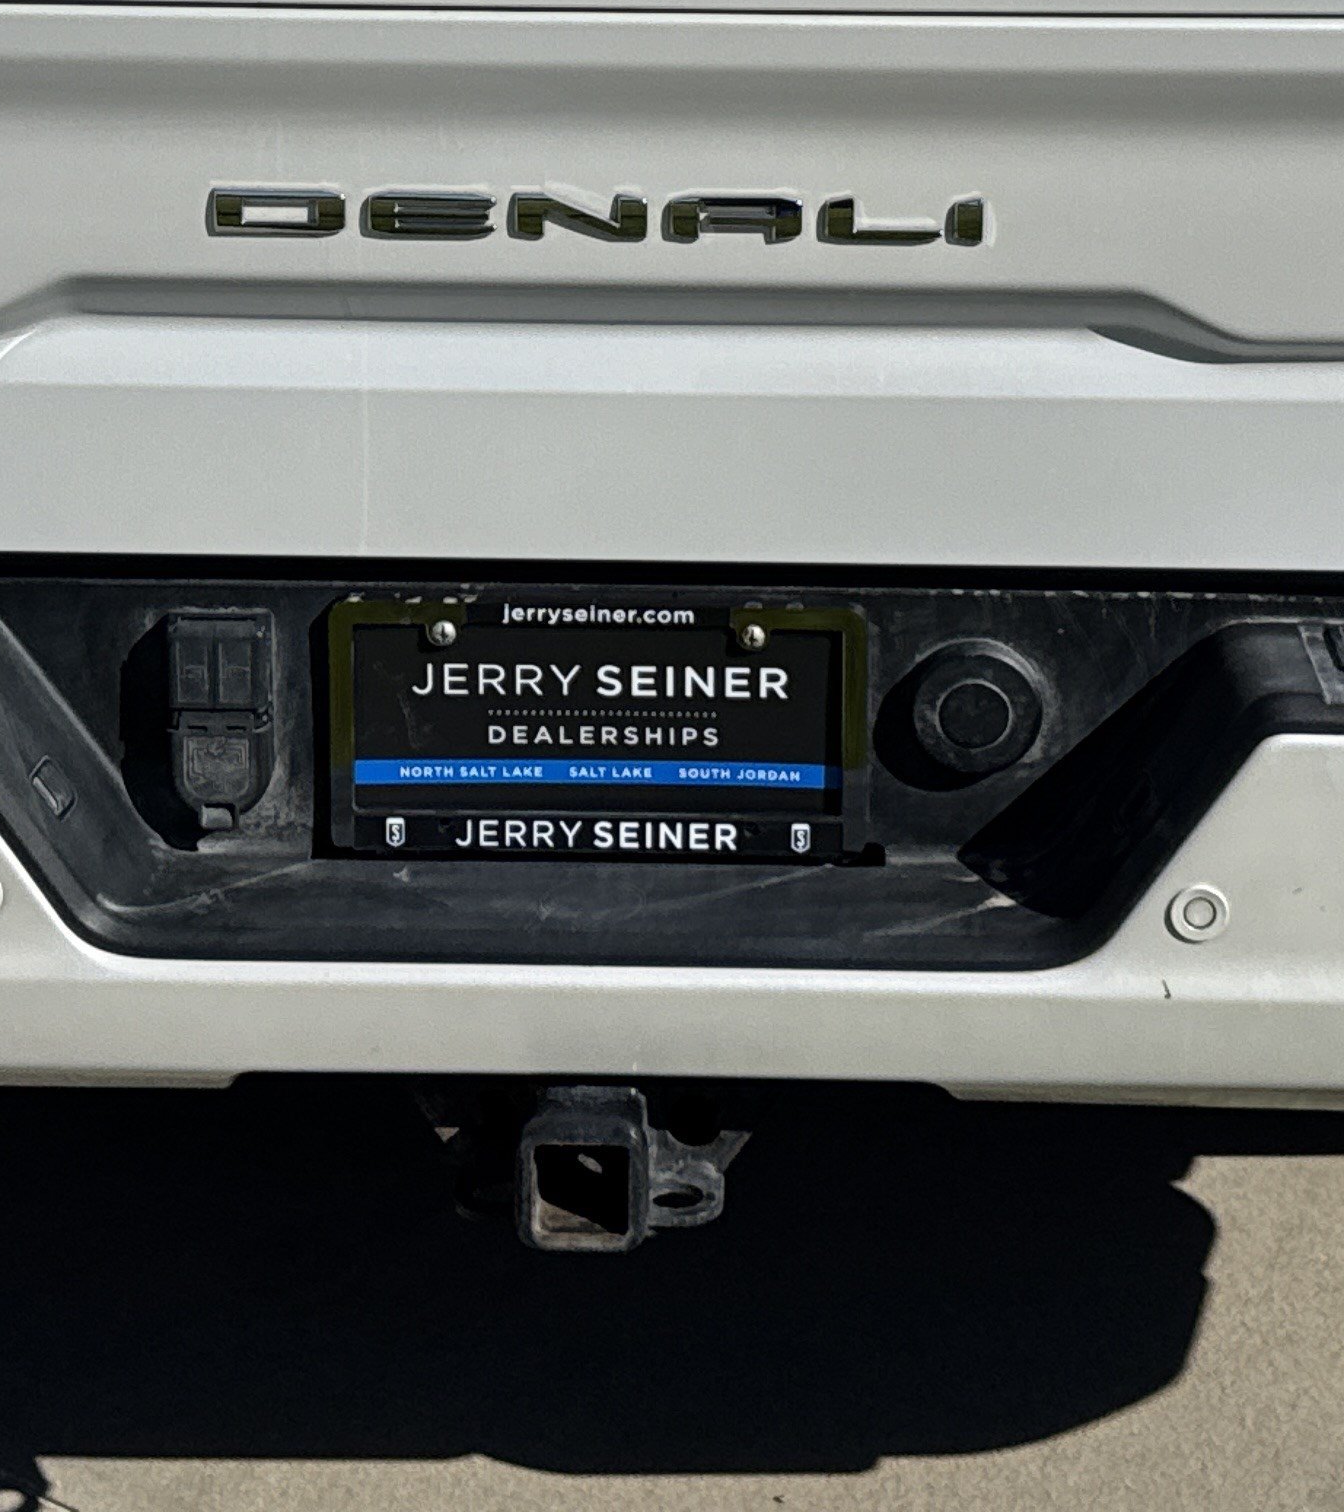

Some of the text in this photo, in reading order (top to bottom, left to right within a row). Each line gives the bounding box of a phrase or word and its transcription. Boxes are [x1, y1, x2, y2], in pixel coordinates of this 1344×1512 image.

[206, 187, 987, 245] DENALI
[502, 603, 695, 625] jerryseiner.com
[411, 662, 789, 699] JERRY SEINER
[488, 725, 719, 746] DEALERSHIPS
[400, 766, 800, 781] NORTH SALT LAKE SALT LAKE SOUTH JORDAN
[455, 819, 582, 848] JERRY
[593, 821, 737, 851] SEINER
